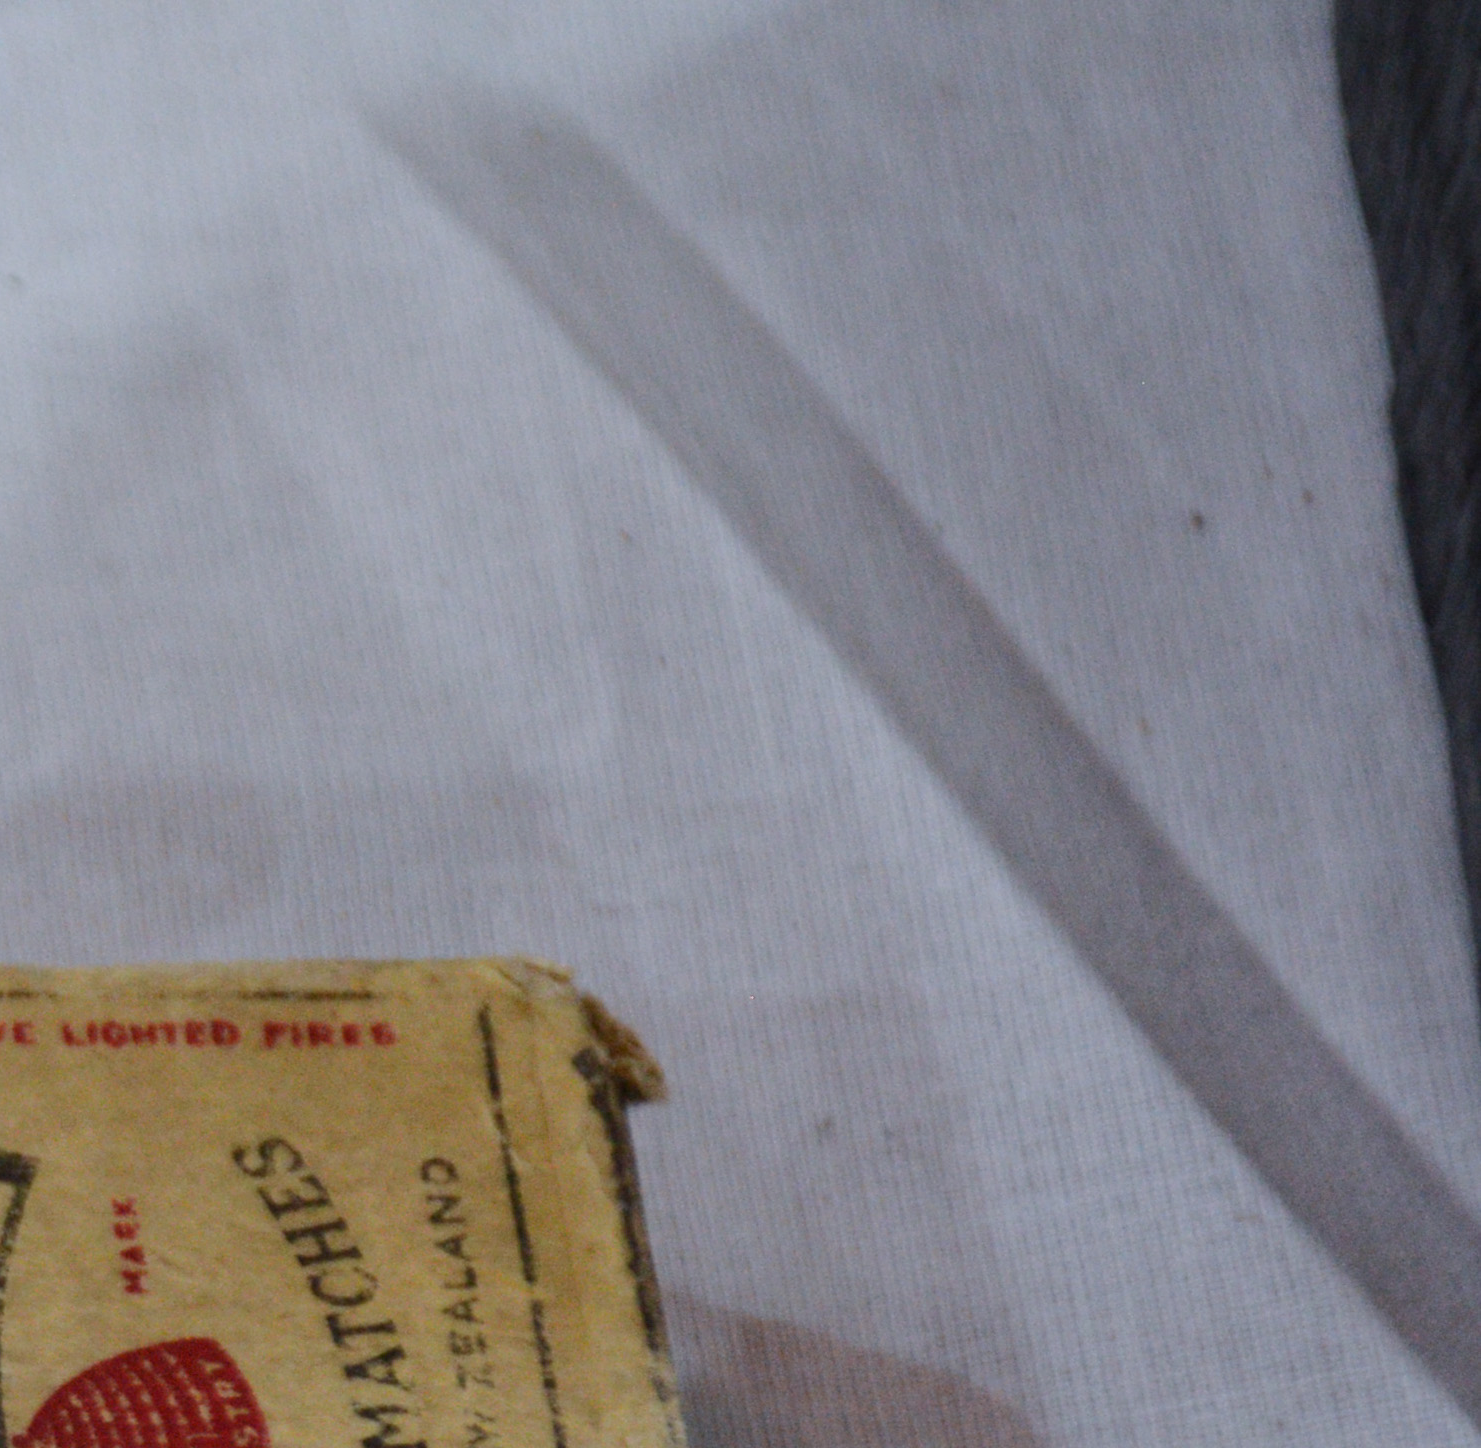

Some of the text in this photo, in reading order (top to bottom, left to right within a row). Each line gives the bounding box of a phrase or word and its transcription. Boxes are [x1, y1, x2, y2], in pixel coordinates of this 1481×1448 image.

[61, 1018, 241, 1048] LIGHTED
[262, 1018, 397, 1049] FIRES
[111, 1195, 150, 1296] MARK
[419, 1156, 496, 1390] ZEALAND
